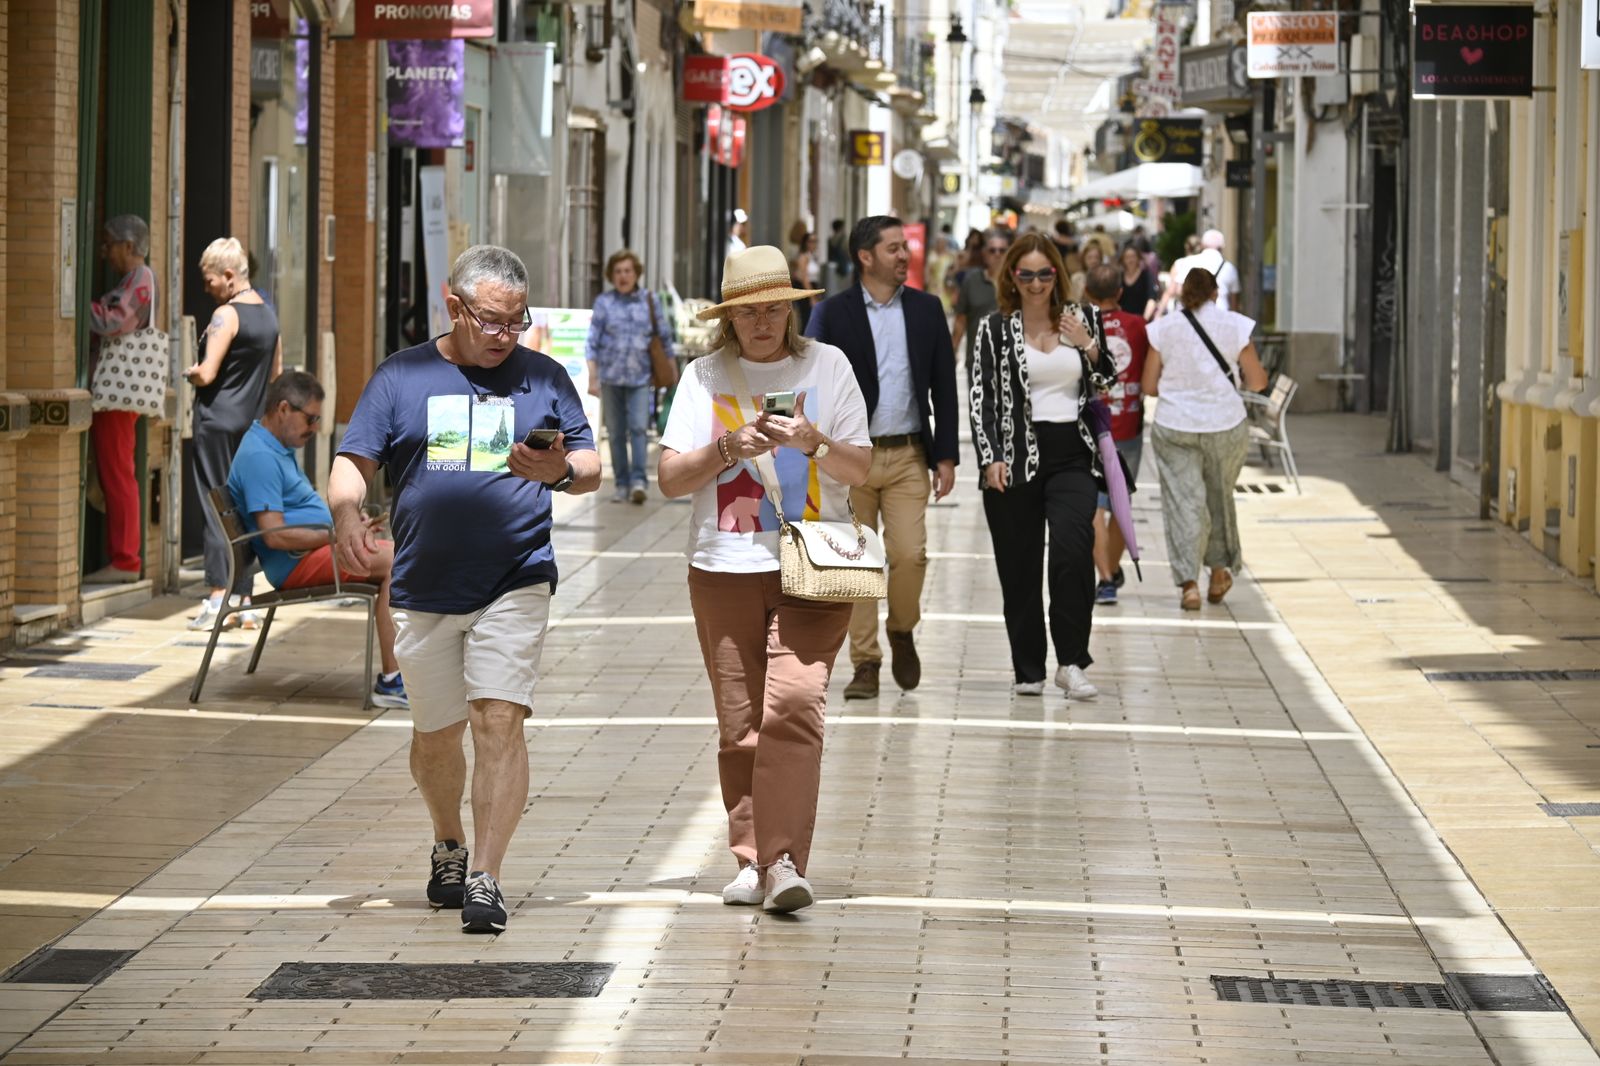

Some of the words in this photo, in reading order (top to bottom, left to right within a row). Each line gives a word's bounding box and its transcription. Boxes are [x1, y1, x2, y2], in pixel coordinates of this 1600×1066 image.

[374, 4, 472, 20] PRONOVIAS
[1421, 23, 1527, 41] BEASHOP
[385, 66, 459, 81] PLANETA
[1421, 74, 1449, 84] LOLA
[426, 464, 440, 472] VAN
[442, 464, 466, 472] GOGH
